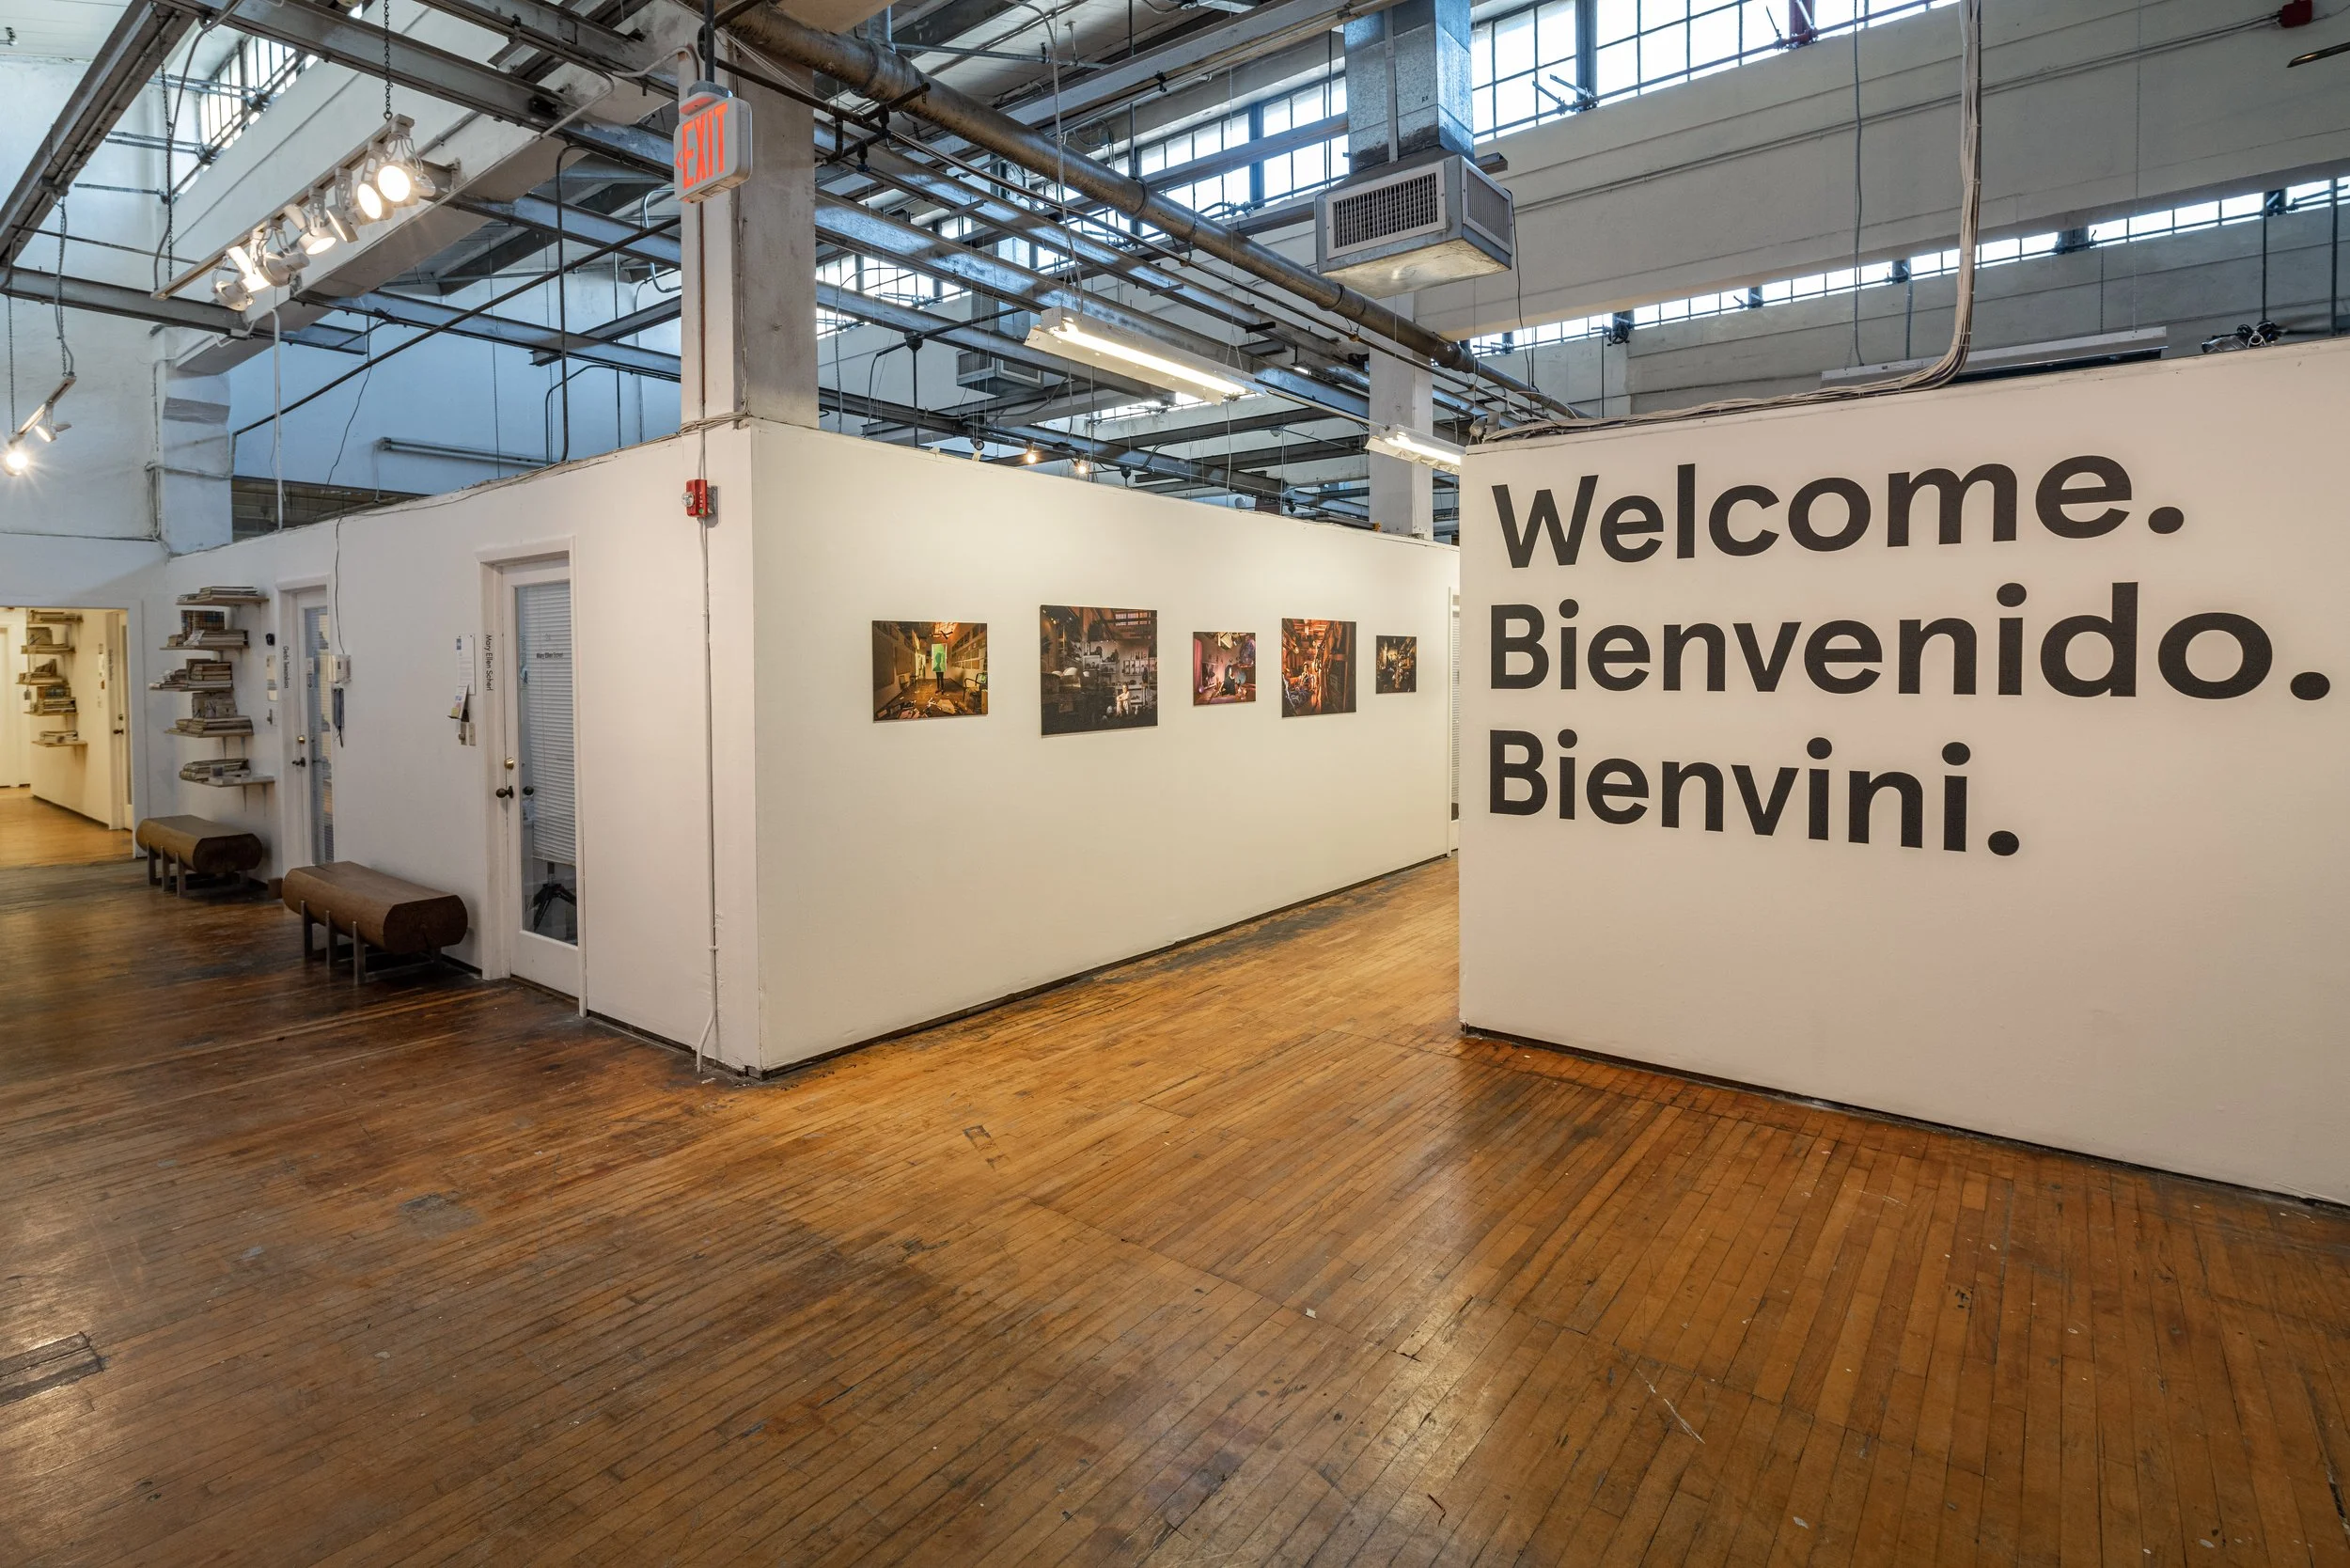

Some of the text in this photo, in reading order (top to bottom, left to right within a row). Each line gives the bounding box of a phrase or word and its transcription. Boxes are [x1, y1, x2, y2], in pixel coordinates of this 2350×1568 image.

[682, 102, 728, 190] EXIT
[1492, 455, 2185, 569] Welcome.
[484, 634, 493, 651] Mary
[485, 652, 494, 669] Ellen
[1490, 582, 2331, 701] Bienvenido.
[1489, 729, 2020, 856] Bienvini.
